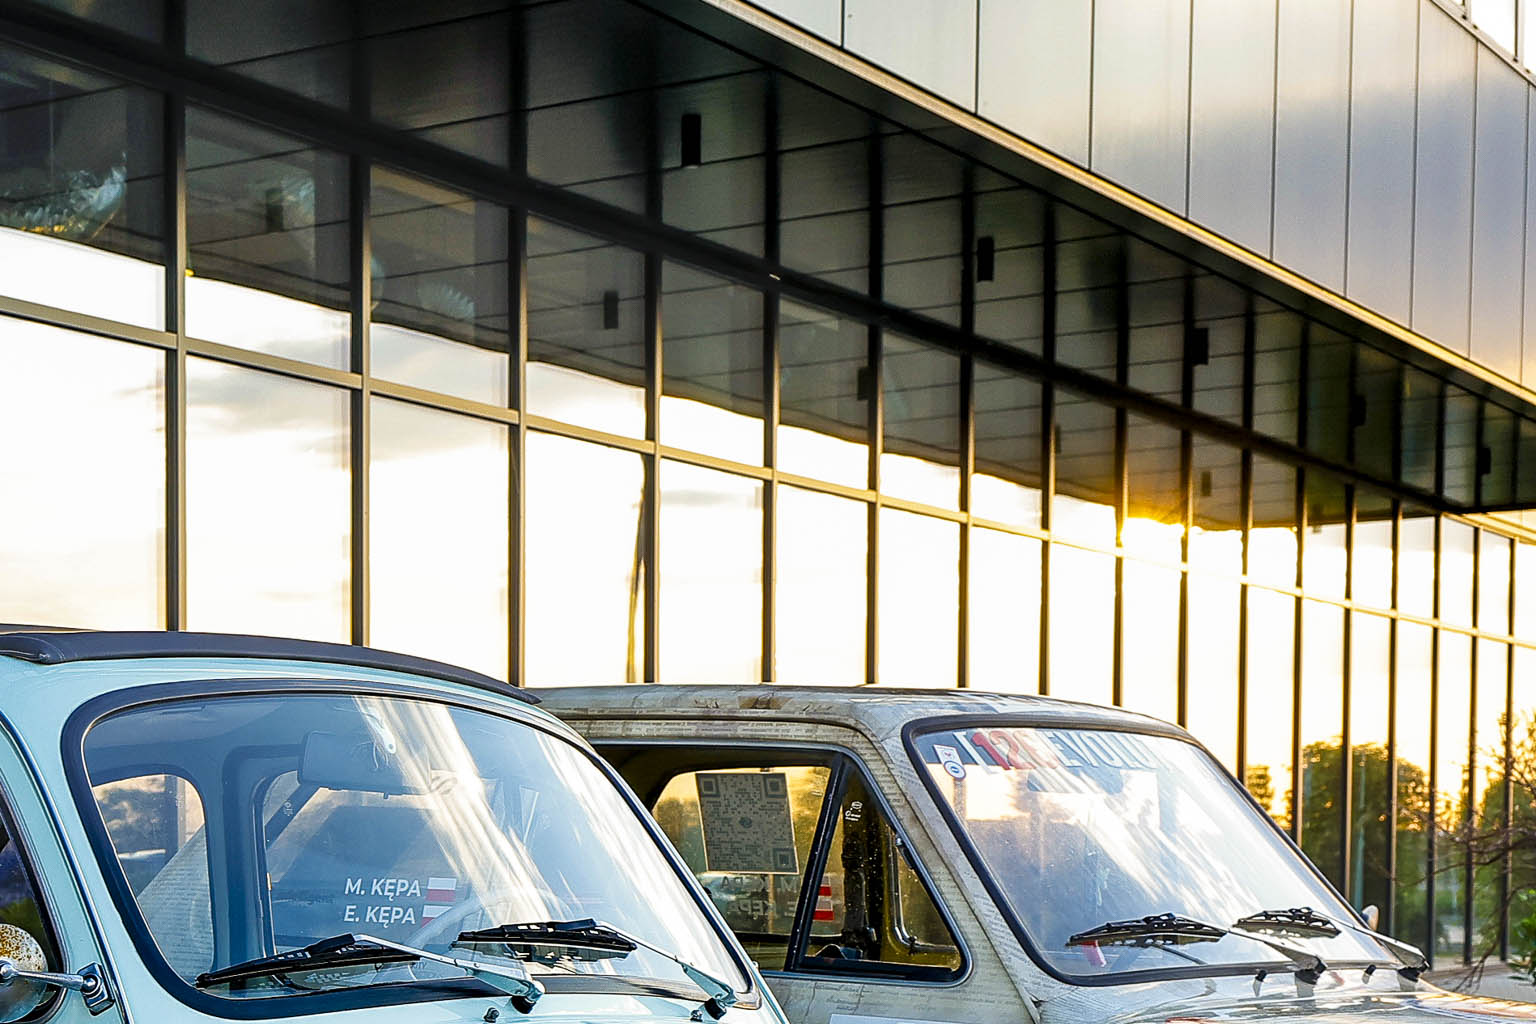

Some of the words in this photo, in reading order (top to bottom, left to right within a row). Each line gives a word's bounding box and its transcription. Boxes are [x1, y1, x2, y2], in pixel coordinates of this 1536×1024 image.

[344, 878, 366, 896] M.
[370, 878, 422, 902] KĘPA
[343, 905, 360, 922] E.
[365, 905, 416, 929] KĘPA
